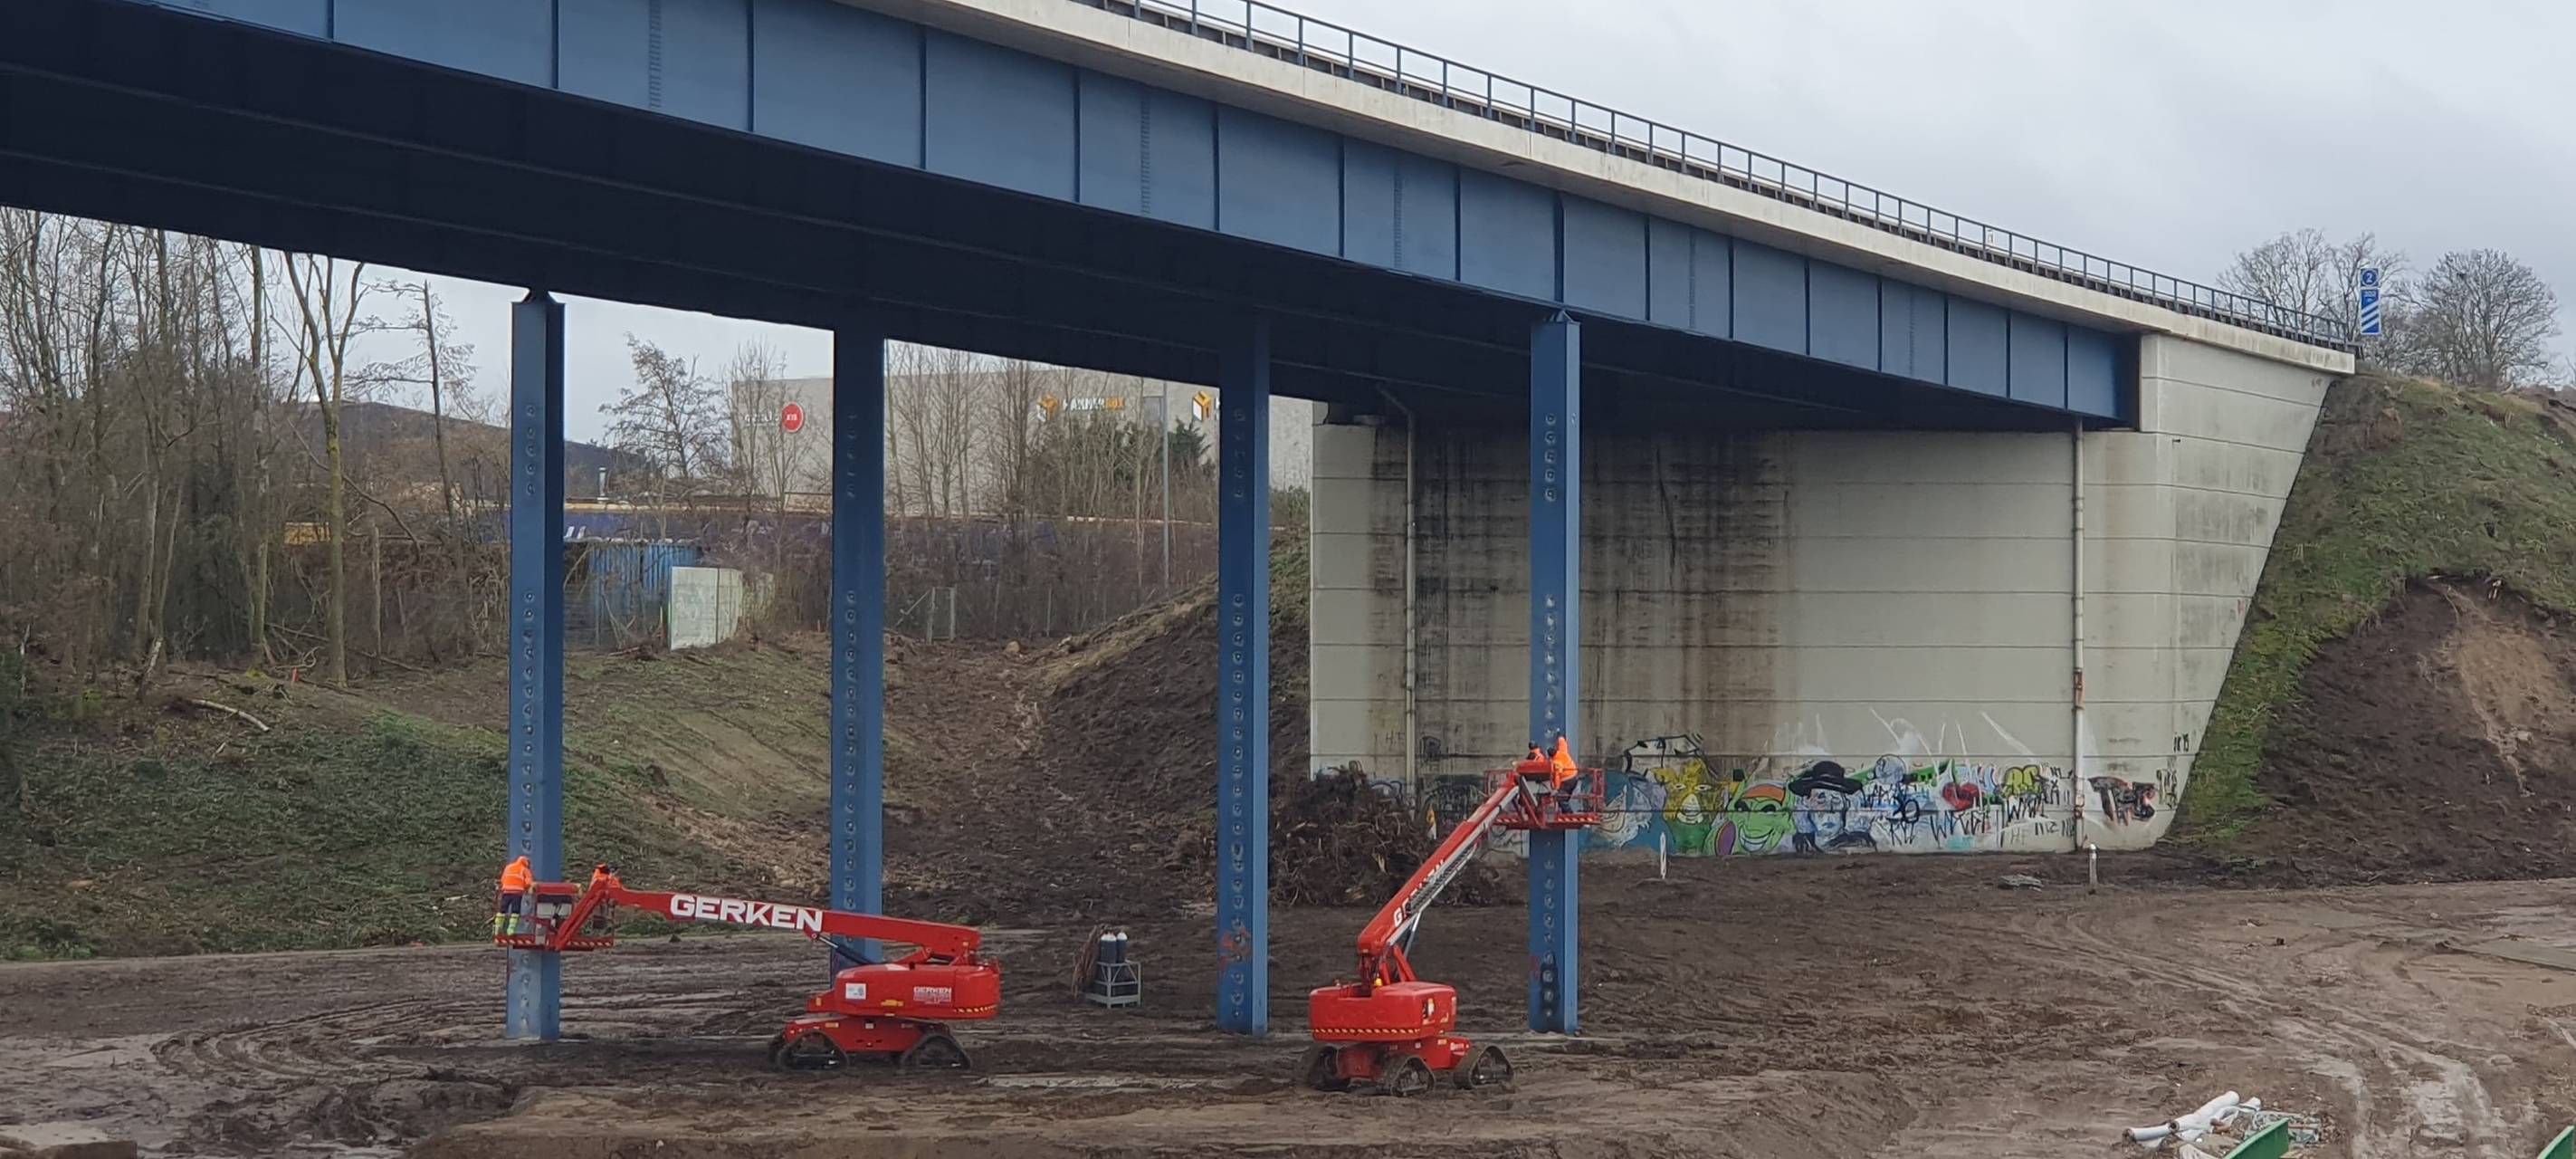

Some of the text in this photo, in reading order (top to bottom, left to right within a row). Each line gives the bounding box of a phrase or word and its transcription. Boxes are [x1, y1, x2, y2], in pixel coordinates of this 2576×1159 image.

[2365, 273, 2373, 283] 2
[670, 893, 824, 933] GERKEN
[913, 986, 952, 994] GERKEN
